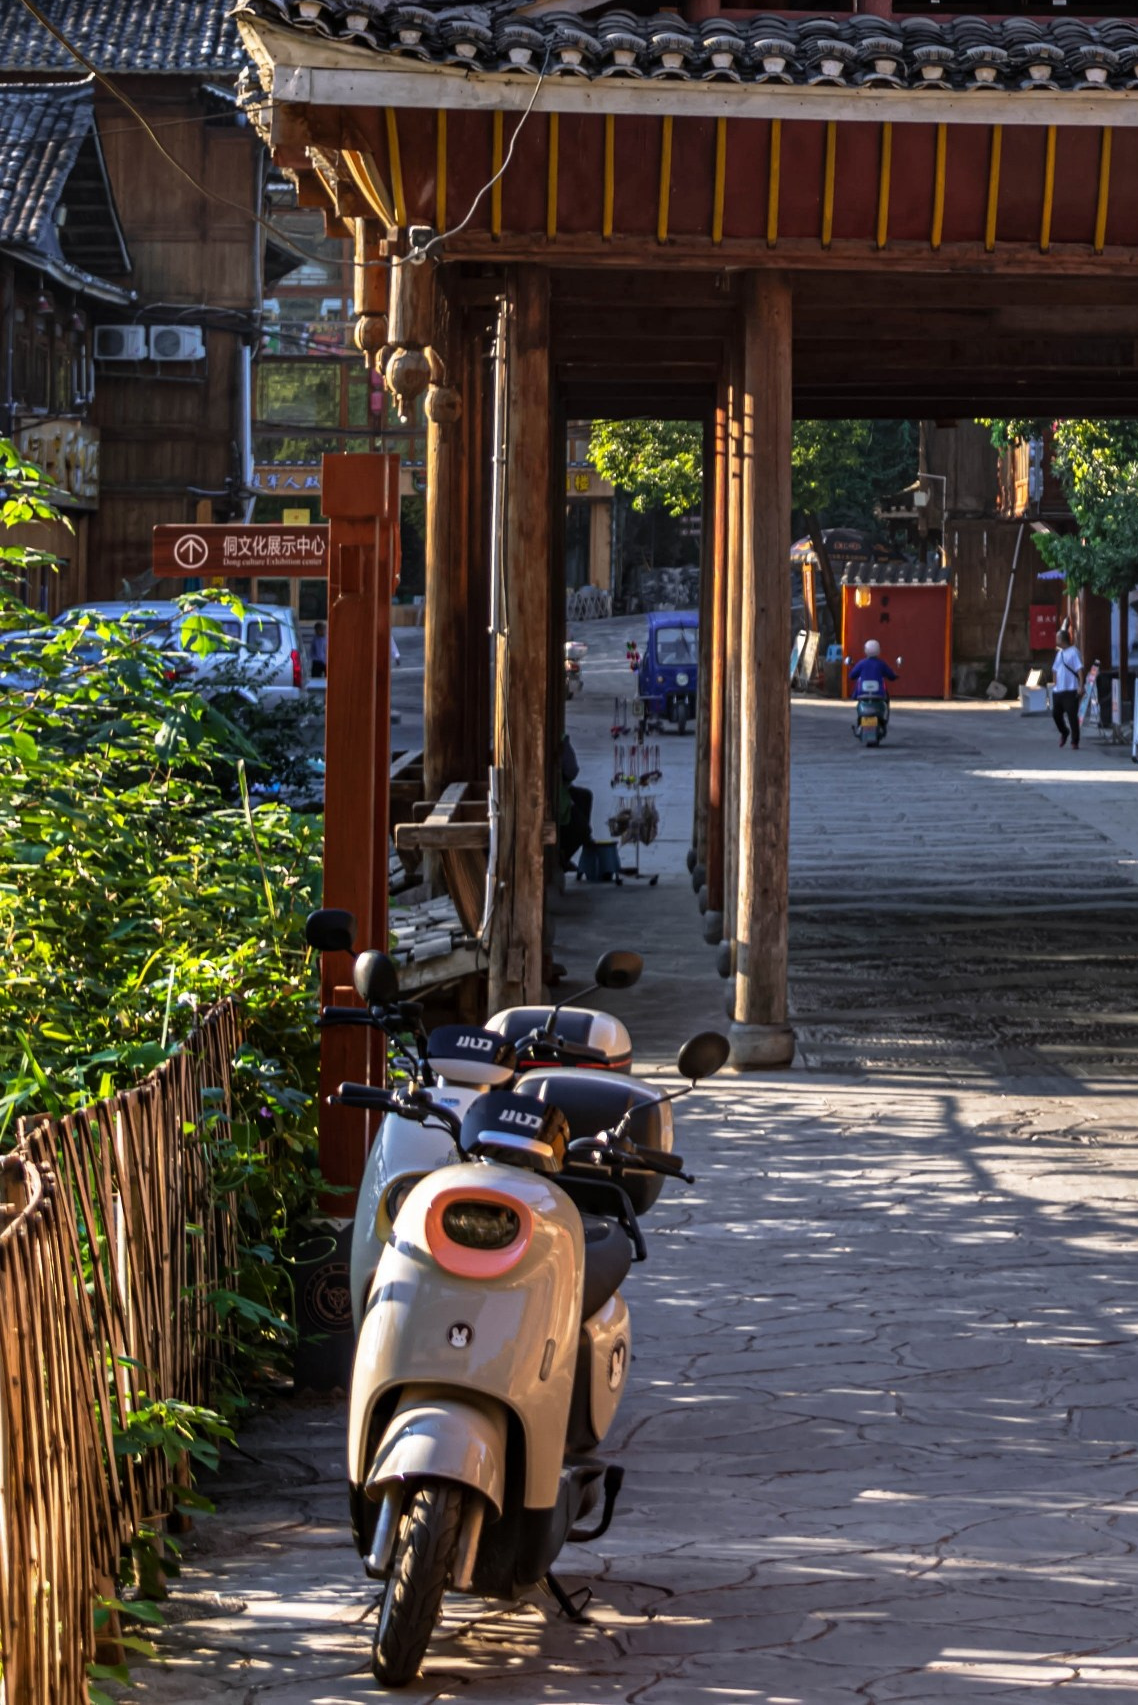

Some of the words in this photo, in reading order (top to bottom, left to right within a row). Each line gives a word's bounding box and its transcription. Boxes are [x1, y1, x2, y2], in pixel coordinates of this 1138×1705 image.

[223, 535, 325, 556] 侗文化展示中心
[223, 558, 240, 567] Dong
